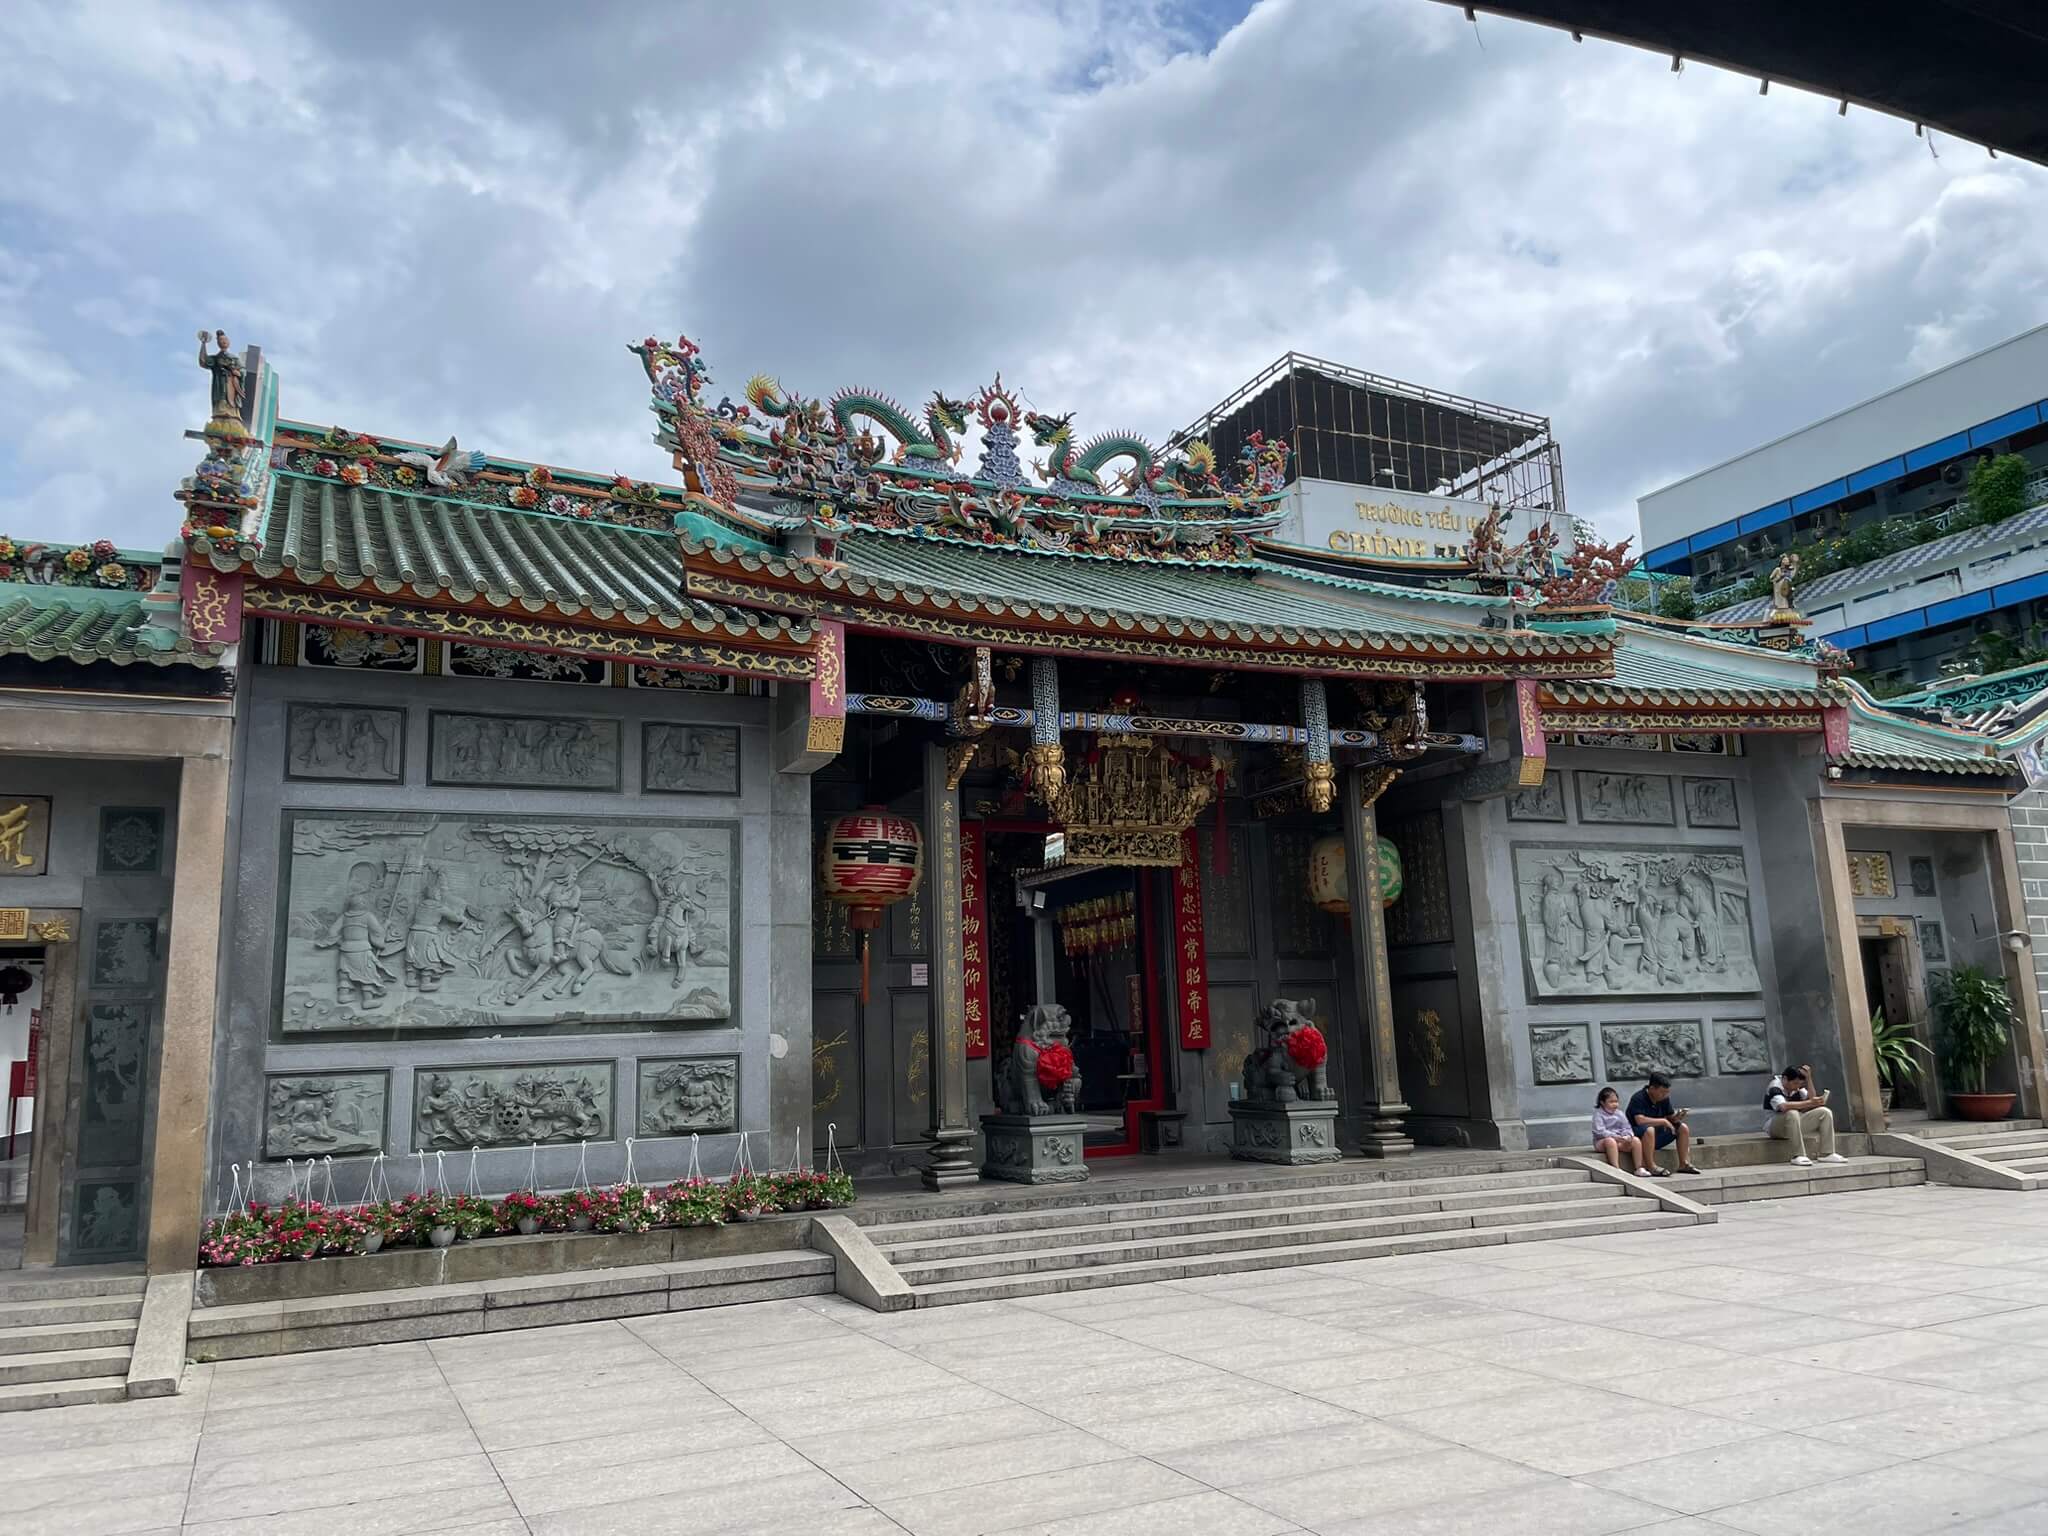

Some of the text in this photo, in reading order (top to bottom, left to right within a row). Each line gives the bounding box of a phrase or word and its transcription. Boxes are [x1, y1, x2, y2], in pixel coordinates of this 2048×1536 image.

[1355, 502, 1423, 527] TRƯỜNG
[1427, 506, 1461, 531] TIỂU
[1329, 528, 1427, 558] CHÍNH
